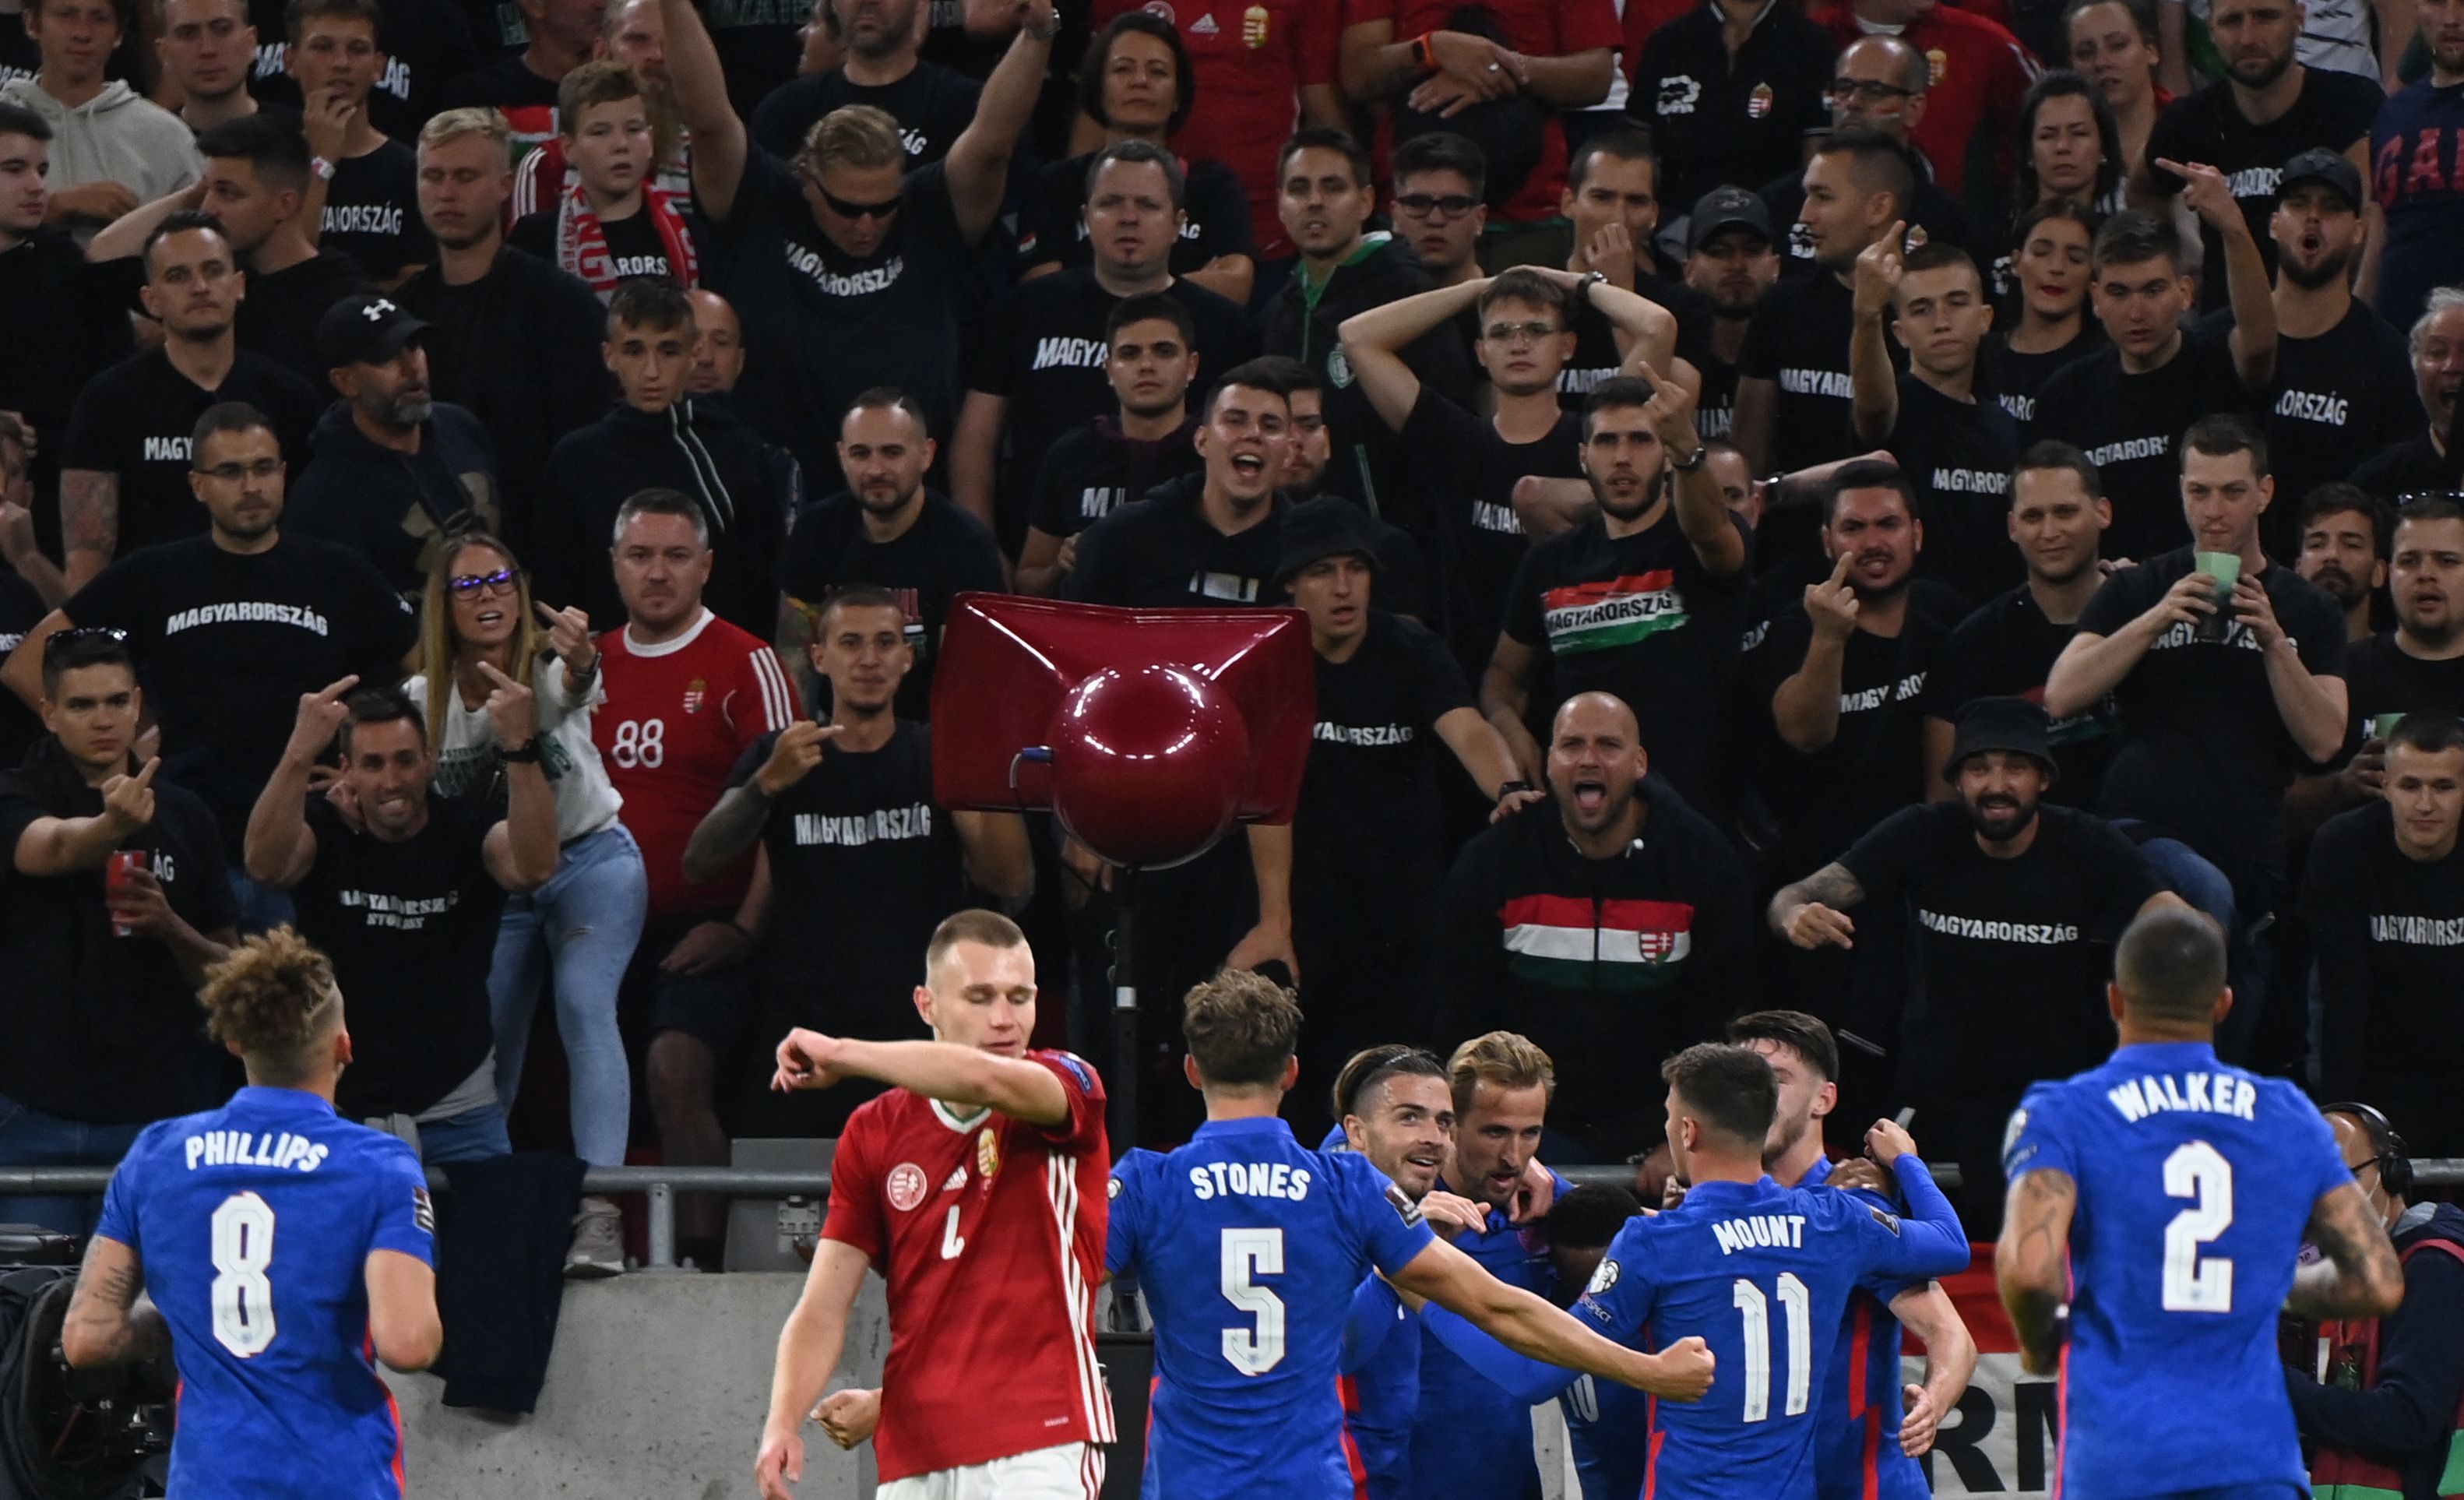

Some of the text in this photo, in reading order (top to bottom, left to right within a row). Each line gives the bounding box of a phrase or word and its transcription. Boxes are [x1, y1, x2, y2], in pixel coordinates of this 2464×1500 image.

[165, 600, 330, 637] MAGYARORSZÁG
[612, 718, 665, 769] 88
[1919, 908, 2079, 945] MAGYARORSZÁG
[2107, 1072, 2257, 1123] WALKER
[185, 1130, 329, 1173] PHILLIPS
[1189, 1161, 1311, 1202] STONES
[1711, 1215, 1806, 1256] MOUNT
[2162, 1140, 2233, 1313] 2
[211, 1190, 276, 1358] 8
[1221, 1227, 1285, 1376] 5
[1733, 1272, 1811, 1424] 11
